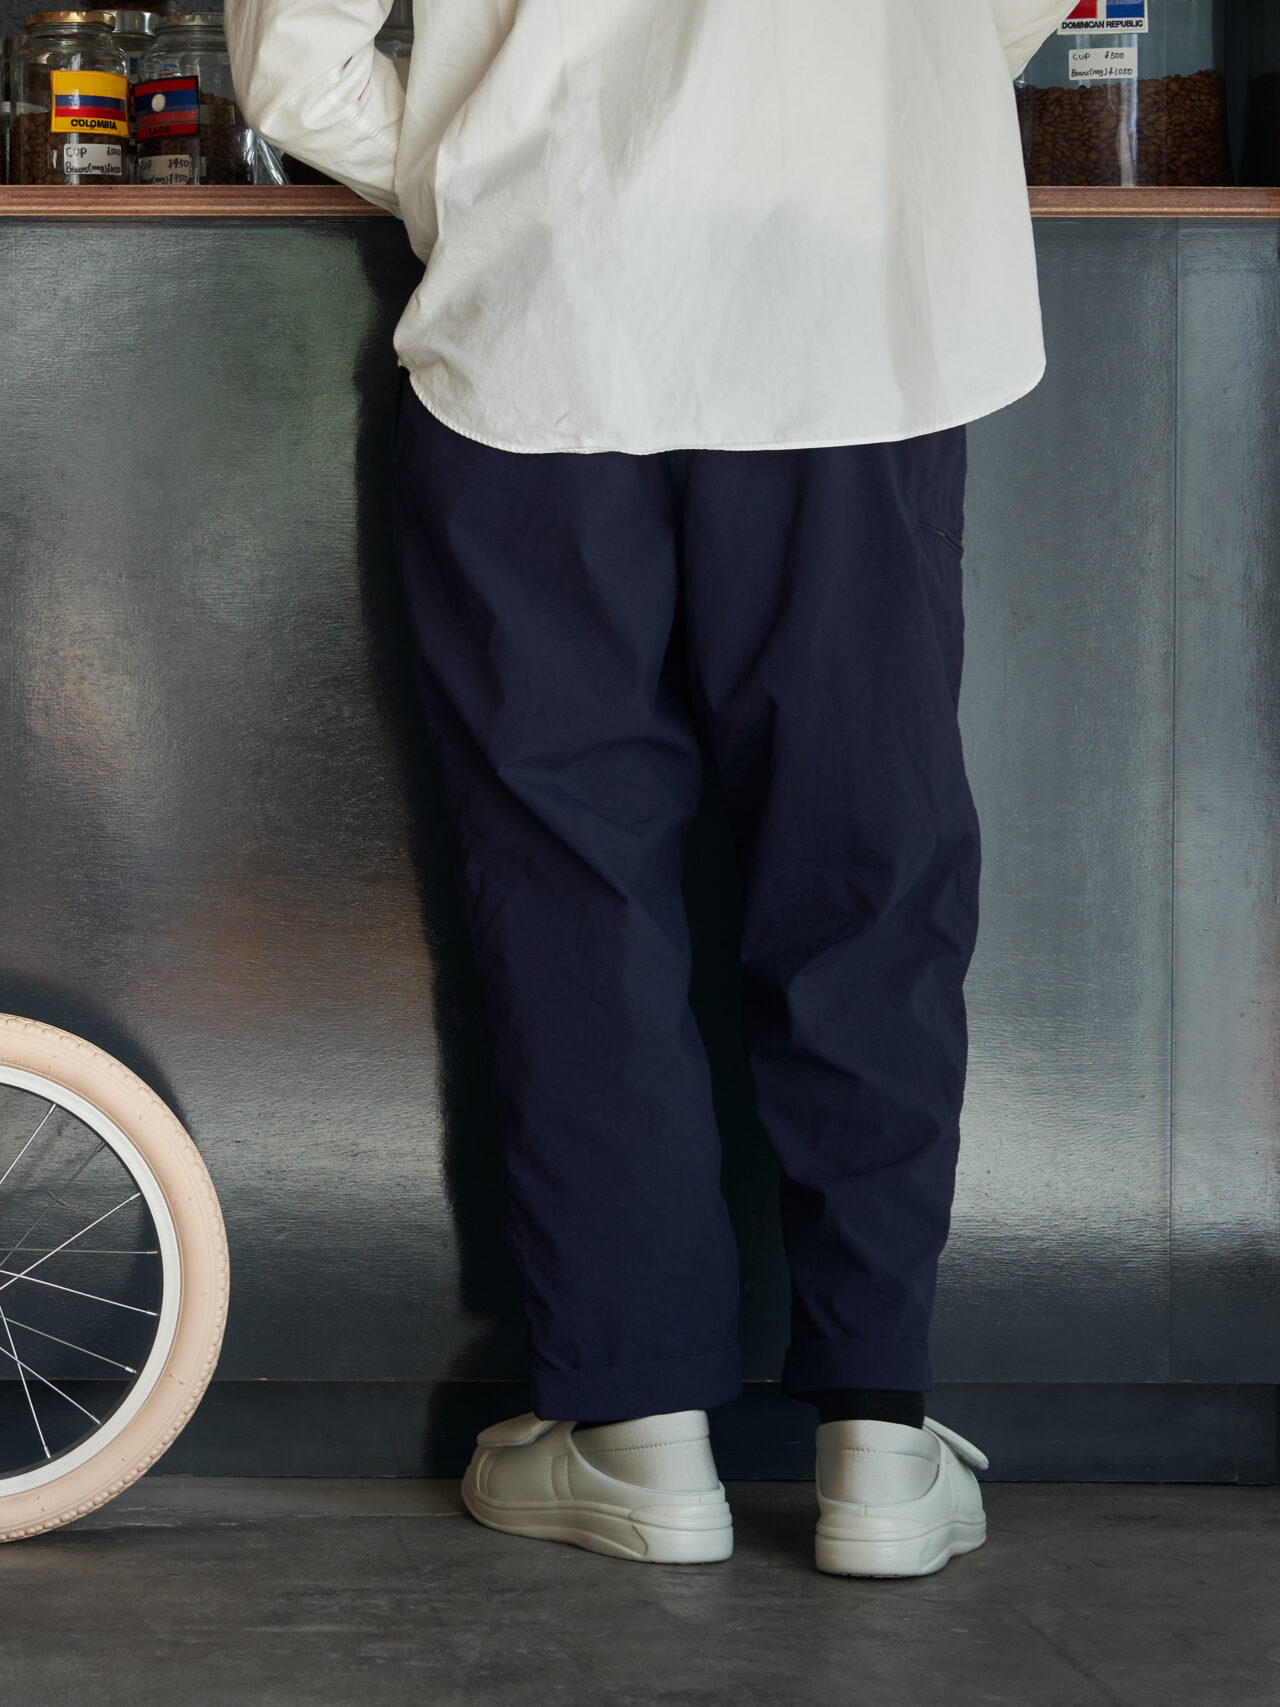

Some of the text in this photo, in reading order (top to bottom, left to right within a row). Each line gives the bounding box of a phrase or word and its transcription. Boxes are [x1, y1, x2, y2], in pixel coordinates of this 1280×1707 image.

[1061, 20, 1144, 29] DOMINICAN REPUBLIC
[70, 118, 118, 130] COLOMBIA
[148, 126, 171, 136] LAOS
